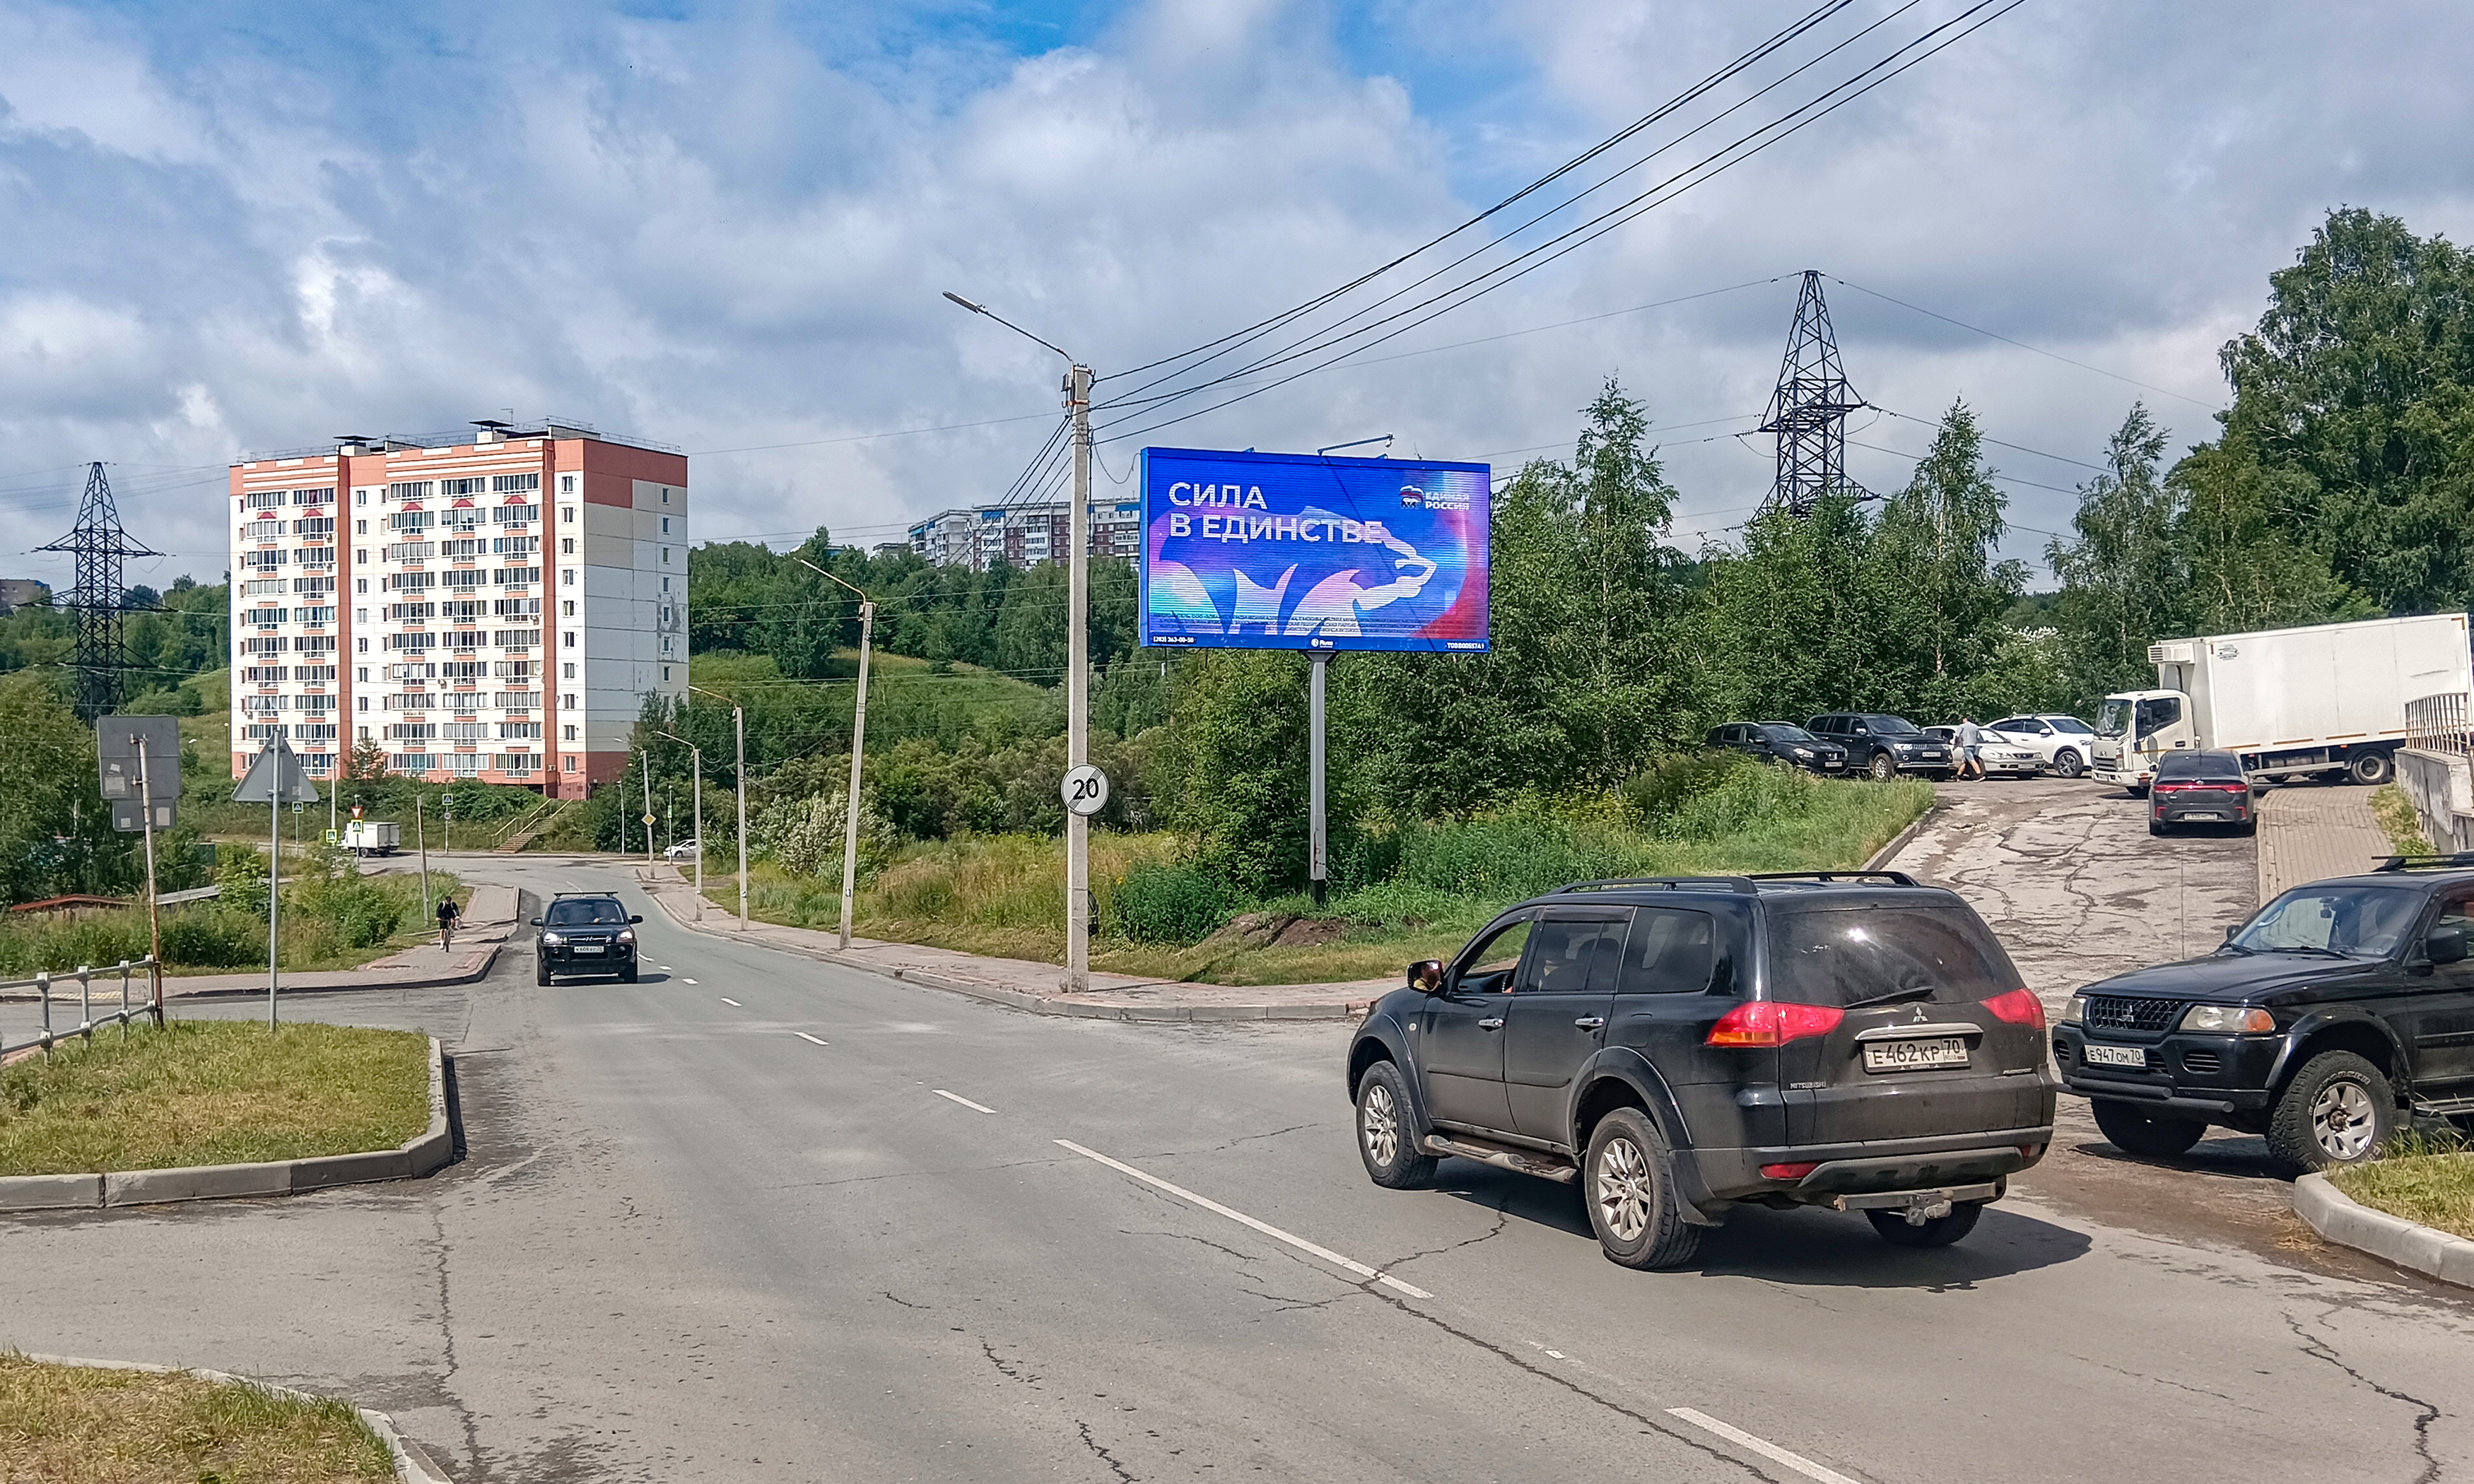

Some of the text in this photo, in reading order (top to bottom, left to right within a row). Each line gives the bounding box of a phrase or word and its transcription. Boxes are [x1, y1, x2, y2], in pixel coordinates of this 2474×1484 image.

[1168, 482, 1267, 510] СИЛА
[1425, 501, 1470, 510] РОССИЯ
[1170, 513, 1383, 543] В ЕДИНСТВЕ
[1072, 778, 1099, 799] 20
